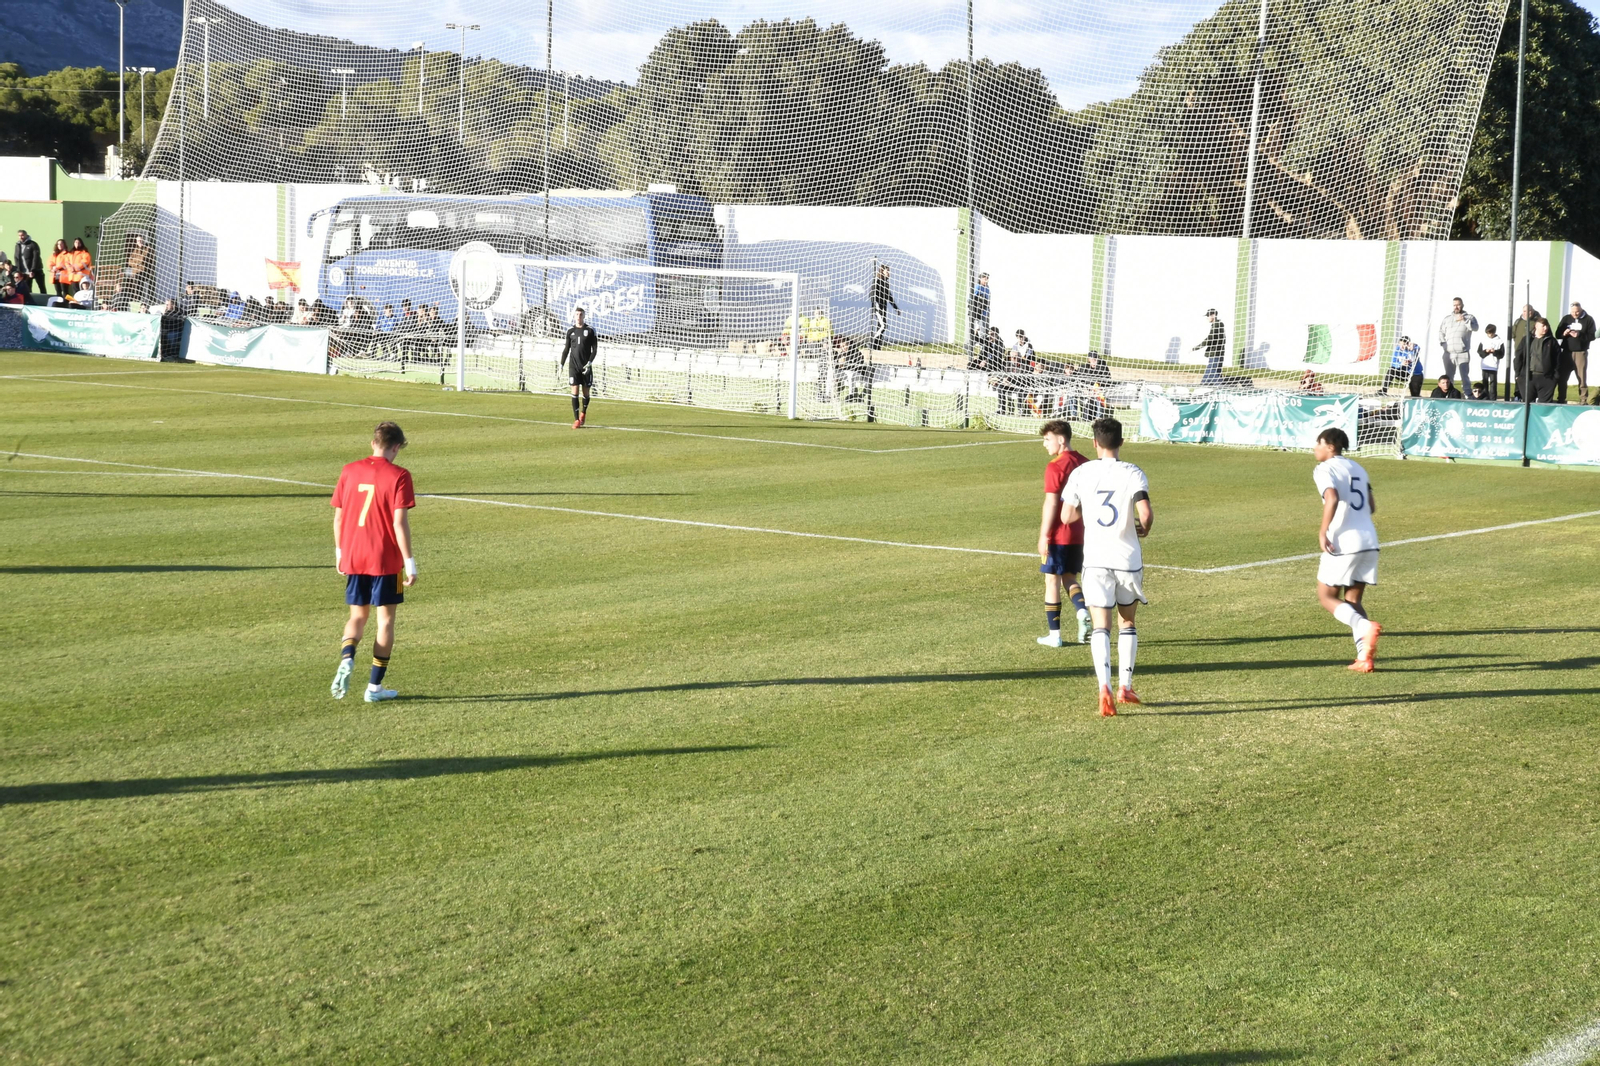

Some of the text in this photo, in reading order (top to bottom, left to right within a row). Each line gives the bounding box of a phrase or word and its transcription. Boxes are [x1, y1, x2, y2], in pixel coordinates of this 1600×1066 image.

[375, 259, 417, 268] JUVENTUD
[356, 266, 419, 277] TORREMOLINOS
[577, 336, 581, 345] 1
[1466, 408, 1490, 417] PACO
[1350, 477, 1365, 511] 5
[358, 484, 375, 527] 7
[1096, 490, 1119, 527] 3
